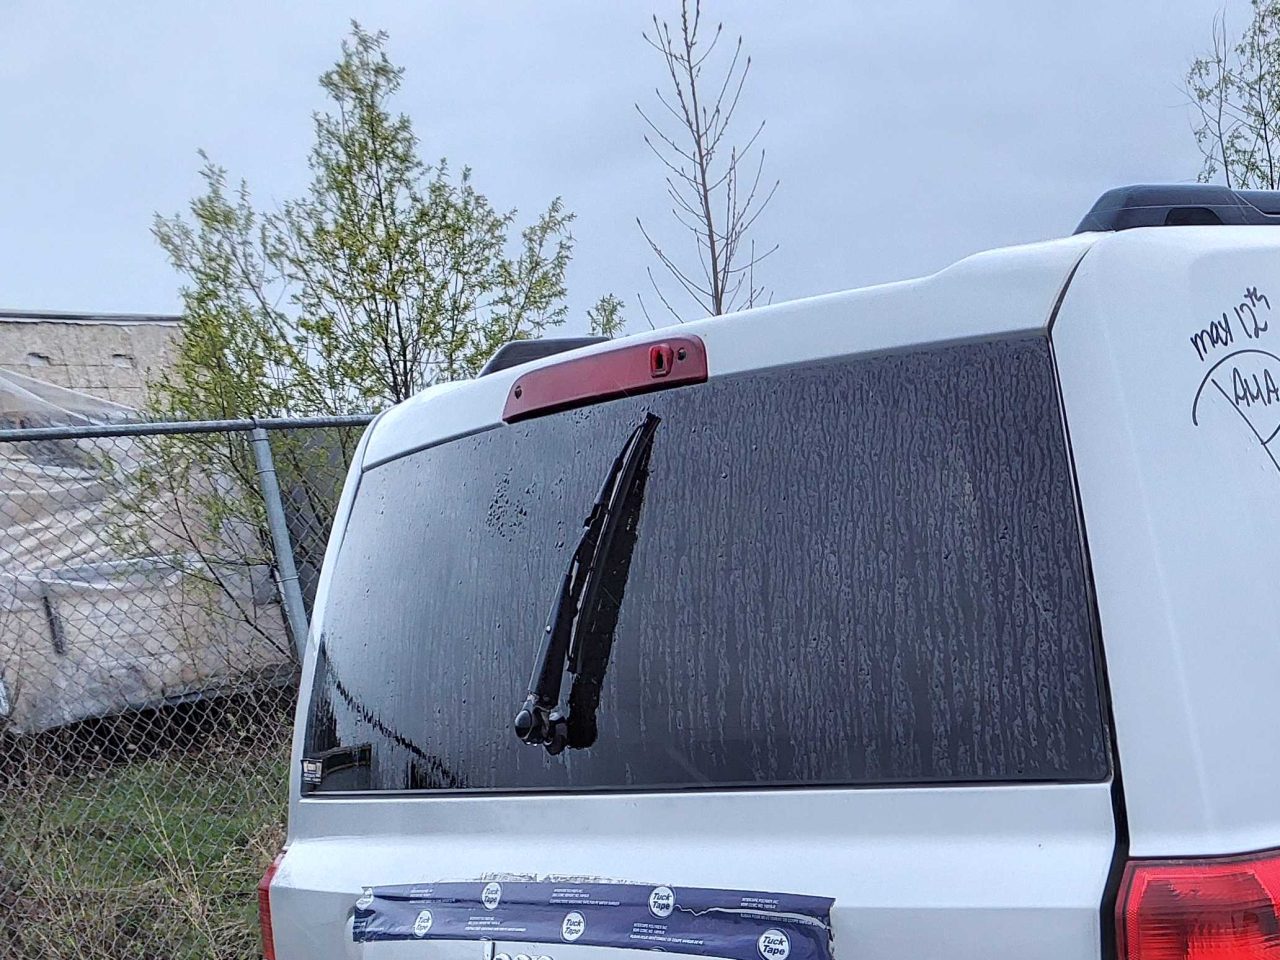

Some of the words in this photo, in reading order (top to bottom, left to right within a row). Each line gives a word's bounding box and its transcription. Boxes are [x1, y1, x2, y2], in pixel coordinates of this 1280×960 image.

[652, 892, 671, 902] Tuck
[652, 901, 670, 911] Tape
[565, 918, 582, 928] Tuck
[563, 926, 582, 936] Tape
[762, 936, 787, 946] Tuck
[762, 945, 786, 955] Tape
